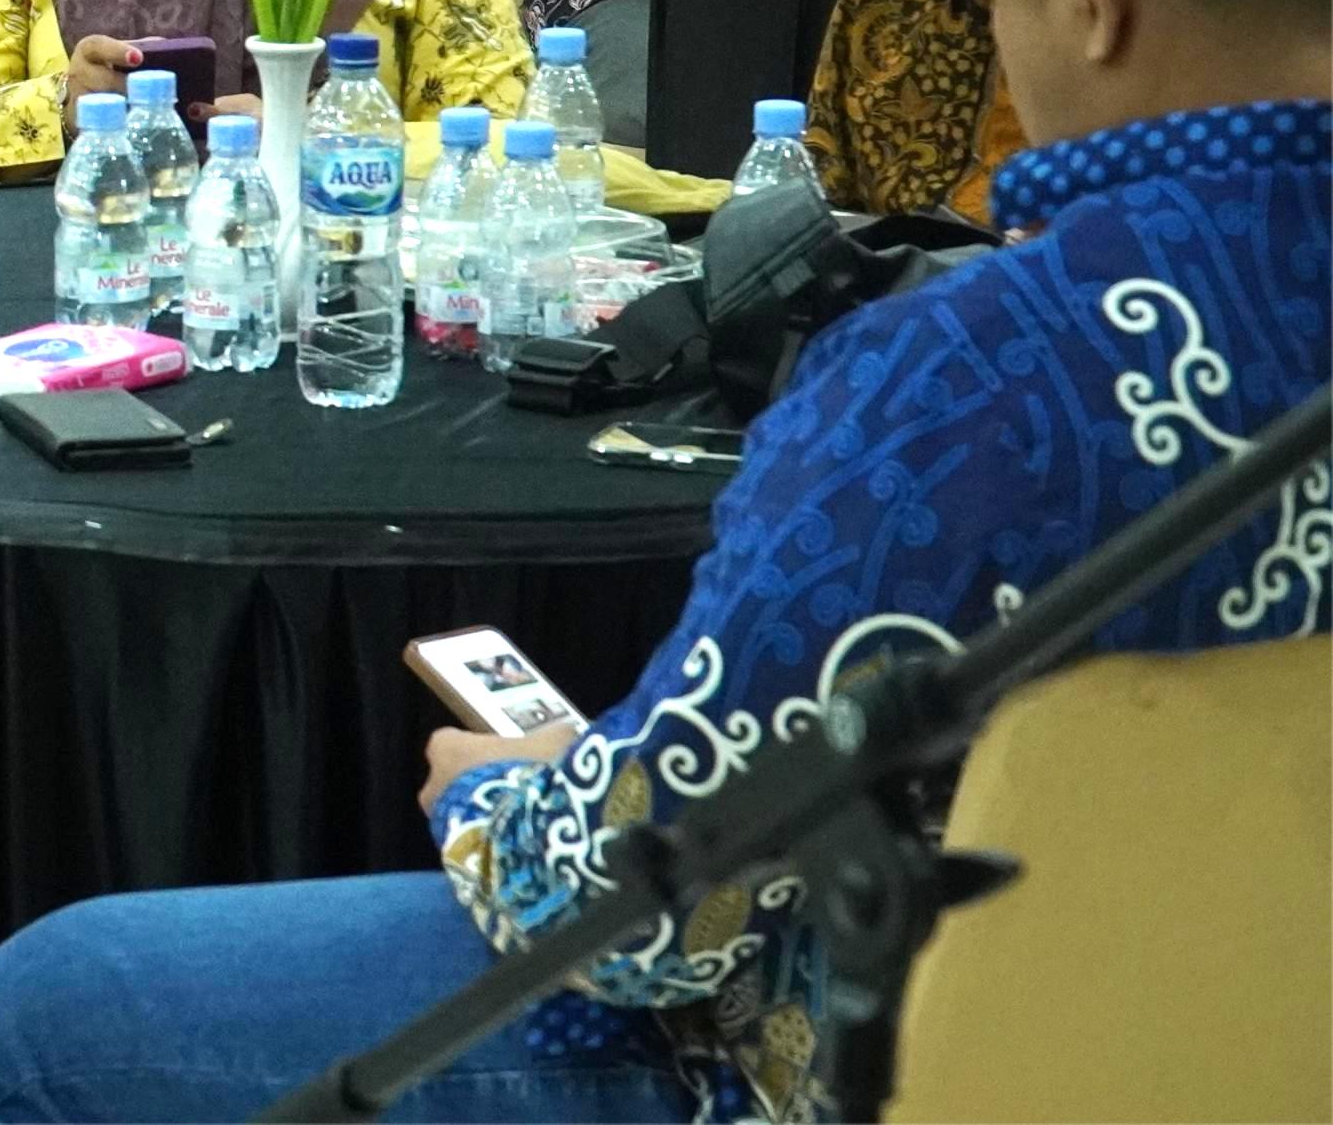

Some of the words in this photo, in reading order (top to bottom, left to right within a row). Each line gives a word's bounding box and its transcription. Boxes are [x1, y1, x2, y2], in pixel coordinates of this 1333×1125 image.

[329, 160, 392, 190] AQUA
[160, 236, 178, 252] Le
[182, 298, 230, 317] nerale
